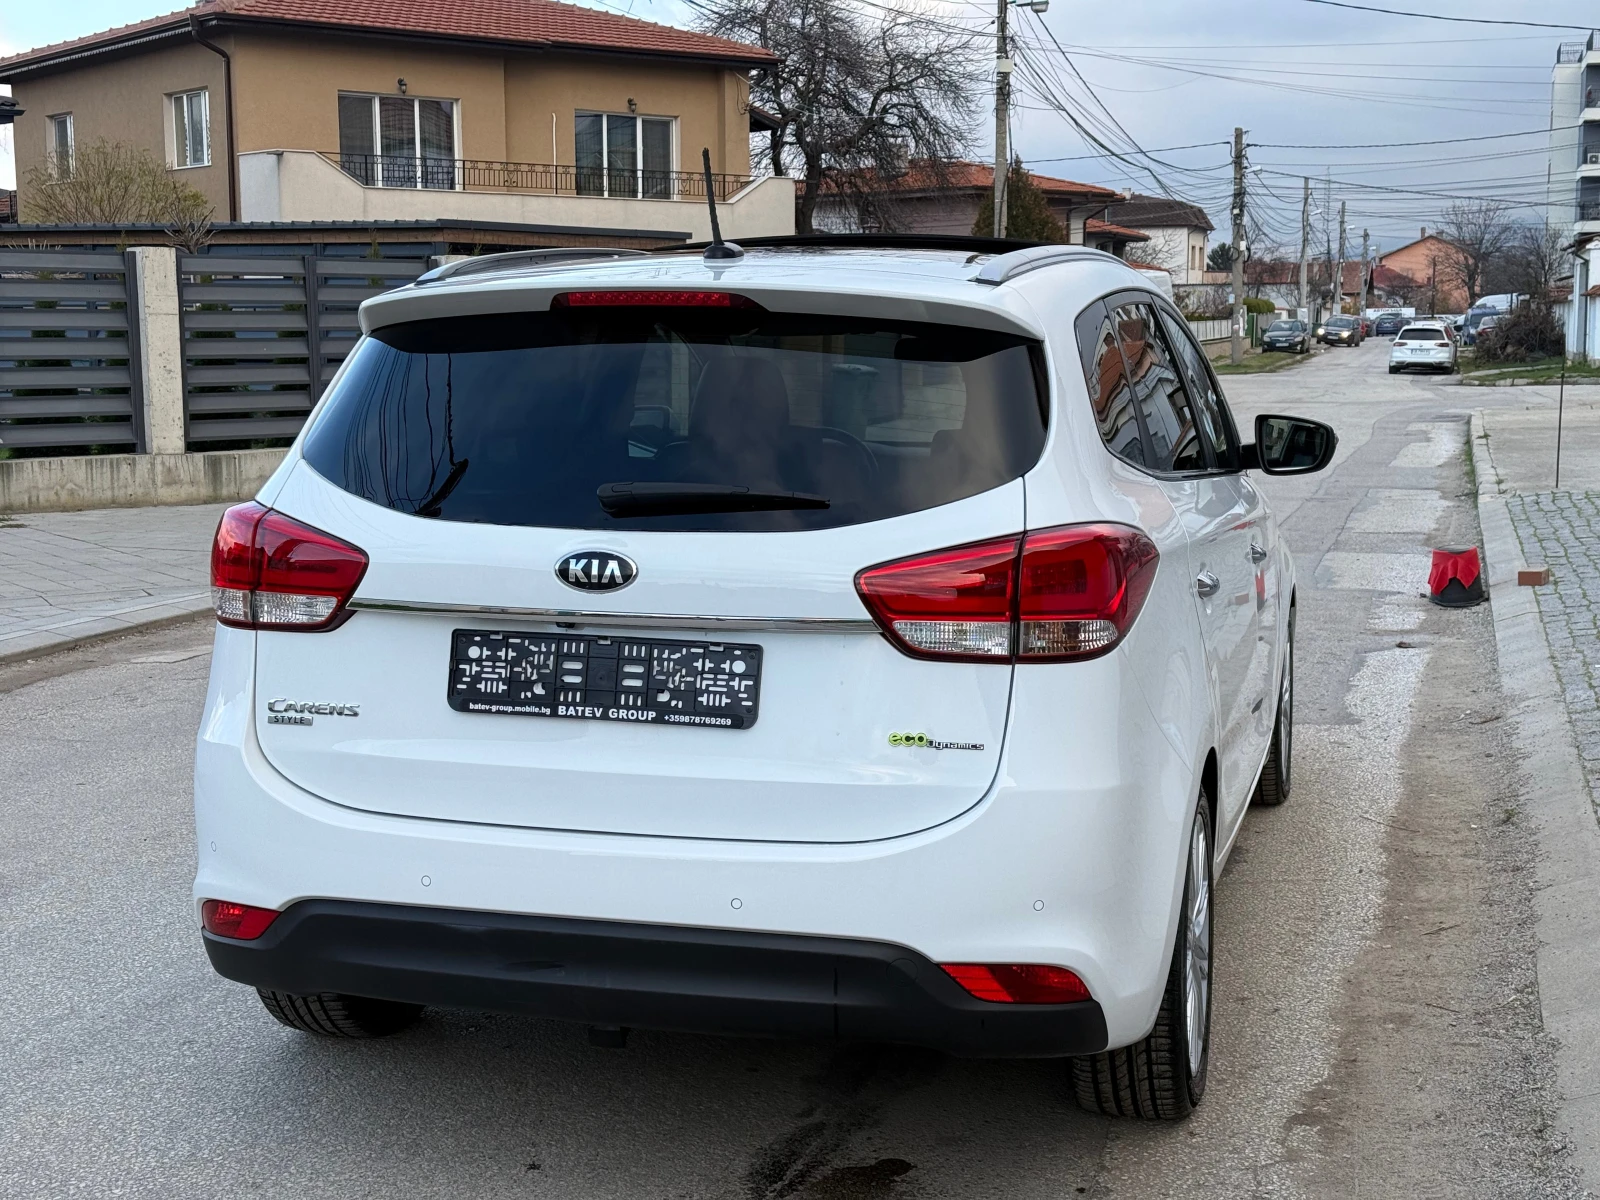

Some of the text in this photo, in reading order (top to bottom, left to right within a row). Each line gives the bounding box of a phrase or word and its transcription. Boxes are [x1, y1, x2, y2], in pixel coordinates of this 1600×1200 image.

[568, 558, 624, 584] KIA
[267, 698, 360, 717] CARENS
[469, 702, 732, 726] batev-group.mobile.bg BATEV GROUP +359878769269
[273, 715, 306, 725] STYLE
